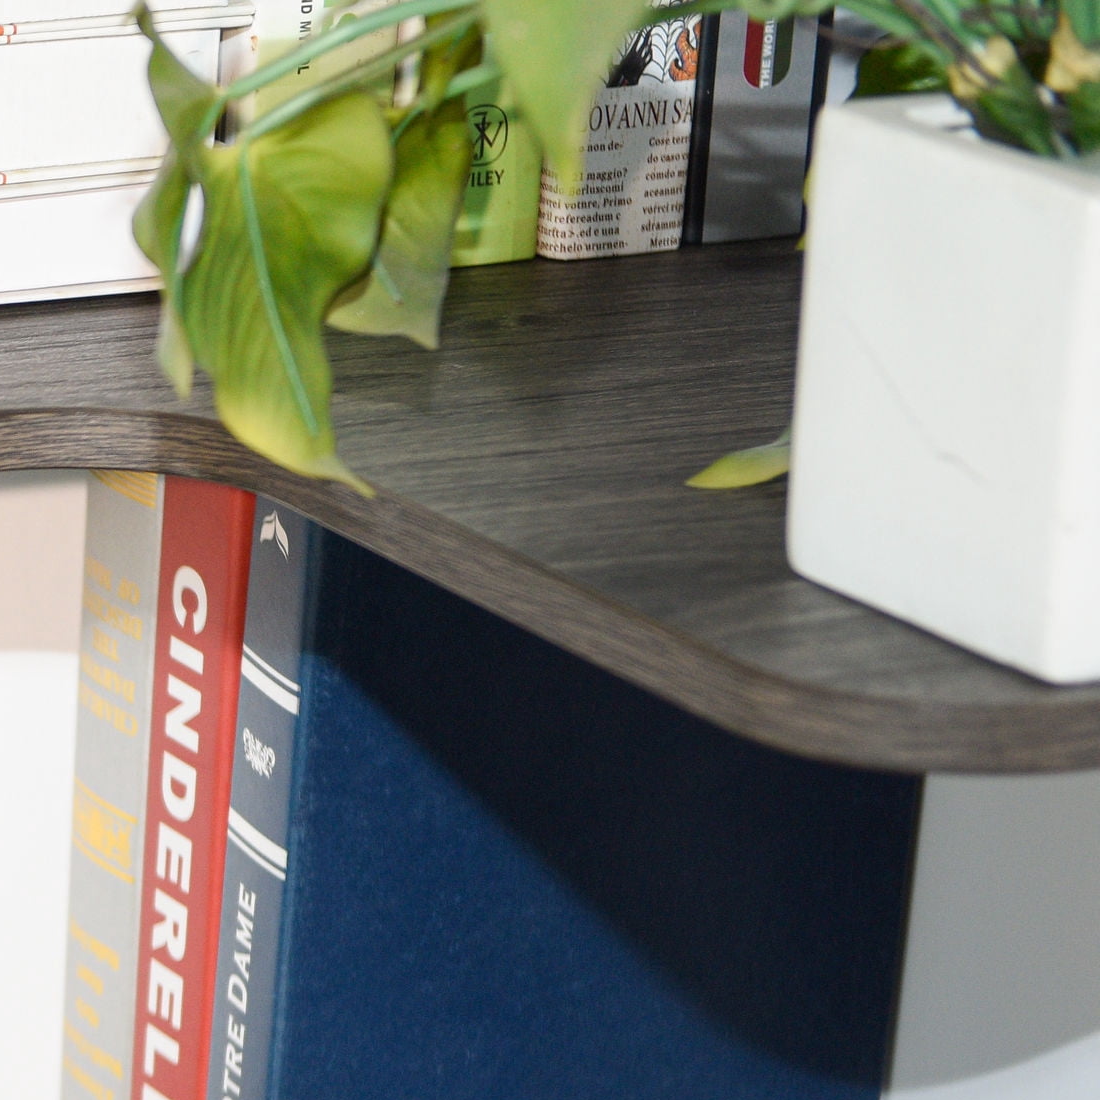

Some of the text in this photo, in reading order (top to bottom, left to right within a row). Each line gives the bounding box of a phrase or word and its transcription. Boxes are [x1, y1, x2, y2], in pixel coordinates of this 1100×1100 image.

[760, 16, 775, 89] THE WORL
[582, 100, 667, 132] OVANNI
[672, 135, 690, 145] terr
[467, 169, 505, 187] ILEY
[228, 881, 257, 1014] DAME
